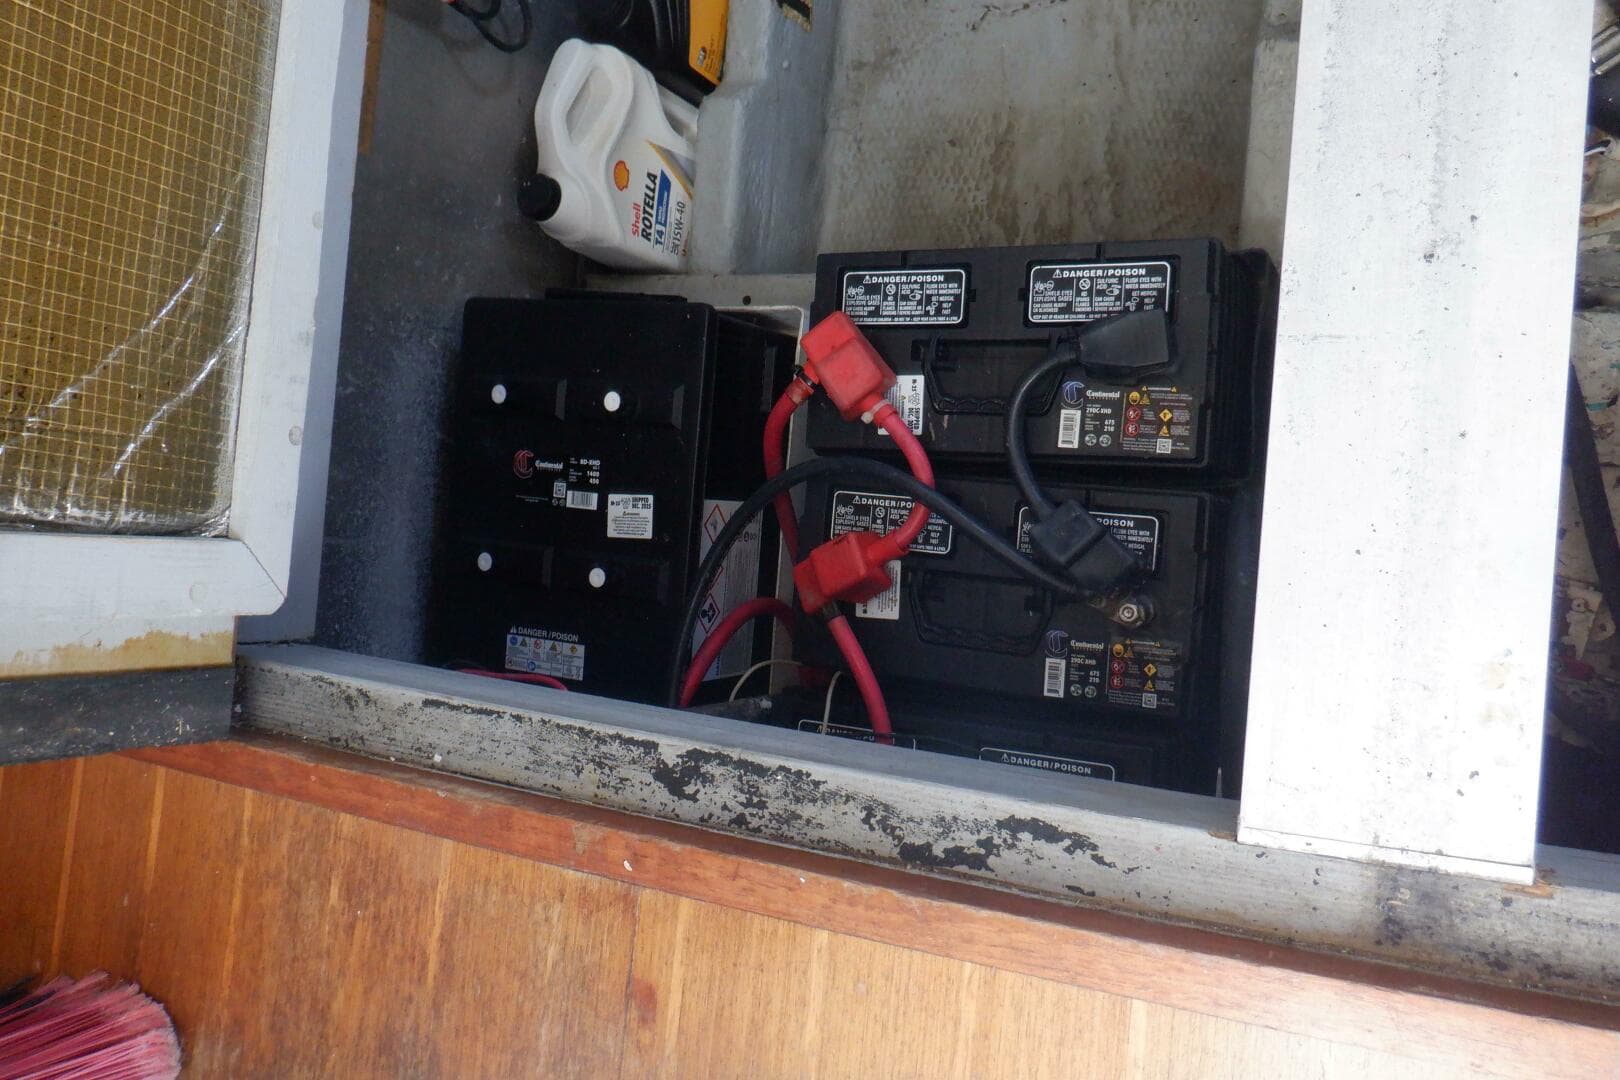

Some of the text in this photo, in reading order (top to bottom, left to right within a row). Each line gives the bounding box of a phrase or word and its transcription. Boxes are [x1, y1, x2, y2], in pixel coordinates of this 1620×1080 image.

[641, 172, 658, 242] ROTELLA
[632, 202, 640, 238] Shell
[673, 201, 686, 242] 15W-40
[656, 229, 664, 246] T4
[872, 275, 944, 283] DANGER/POISON
[1062, 268, 1146, 278] DANGER/POISON
[861, 498, 915, 508] DANGER/POI
[1010, 756, 1091, 774] DANGER/POISON
